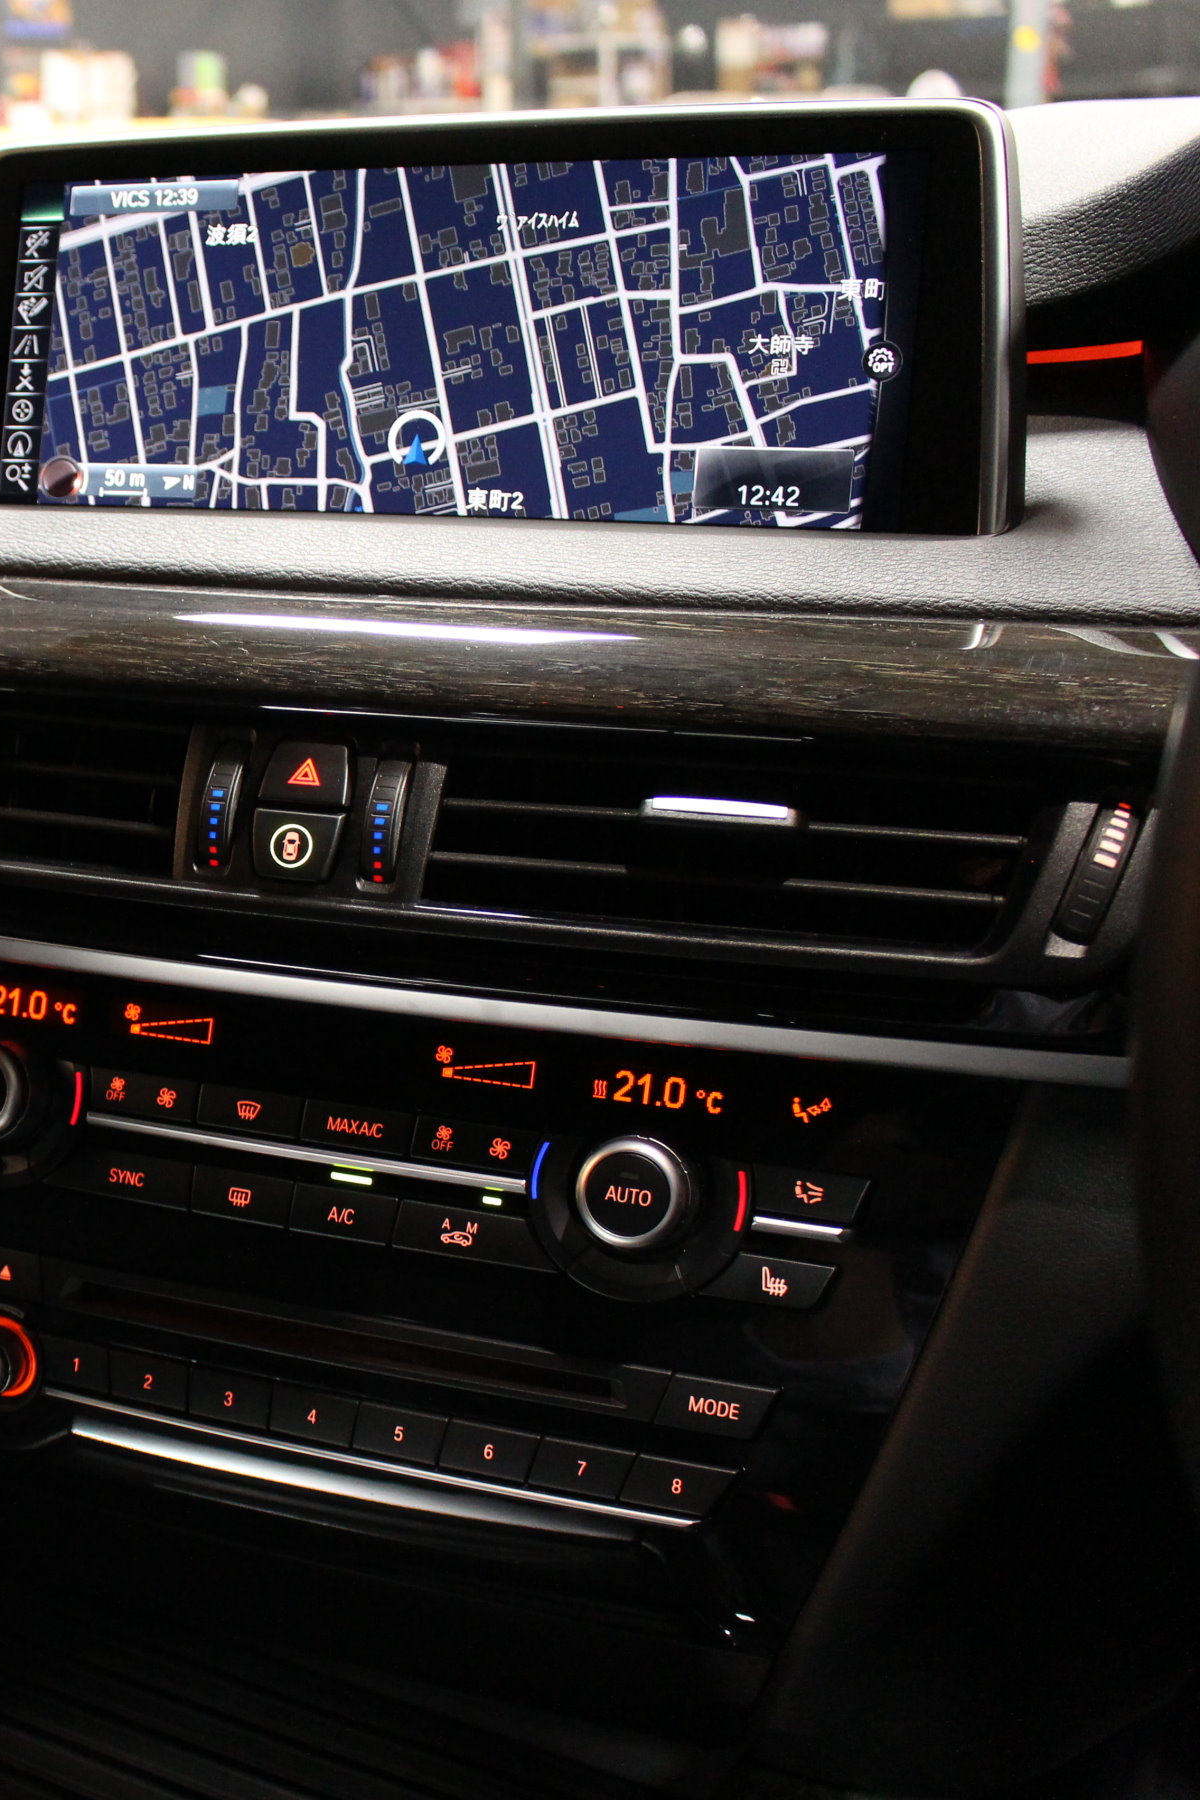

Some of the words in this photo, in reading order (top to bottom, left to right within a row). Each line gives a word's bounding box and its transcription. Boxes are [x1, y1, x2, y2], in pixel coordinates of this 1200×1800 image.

[110, 191, 150, 207] VICS
[155, 189, 199, 206] 12:39
[748, 334, 814, 356] 大師寺
[872, 361, 895, 373] OPT
[104, 470, 126, 487] 50
[130, 474, 145, 487] m
[183, 476, 194, 490] N
[467, 488, 523, 511] 東町2
[738, 485, 800, 507] 12:42
[105, 1089, 126, 1102] OFF
[613, 1069, 687, 1109] 21.0
[431, 1138, 454, 1152] OFF
[109, 1168, 145, 1188] SYNC
[605, 1186, 652, 1207] AUTO
[328, 1206, 355, 1226] A/C
[441, 1217, 451, 1230] A
[466, 1221, 478, 1235] M
[73, 1357, 80, 1372] 1
[143, 1374, 152, 1390] 2
[224, 1391, 234, 1407] 3
[307, 1408, 317, 1424] 4
[688, 1396, 740, 1421] MODE
[393, 1426, 403, 1441] 5
[483, 1444, 493, 1460] 6
[577, 1460, 587, 1476] 7
[671, 1478, 682, 1494] 8
